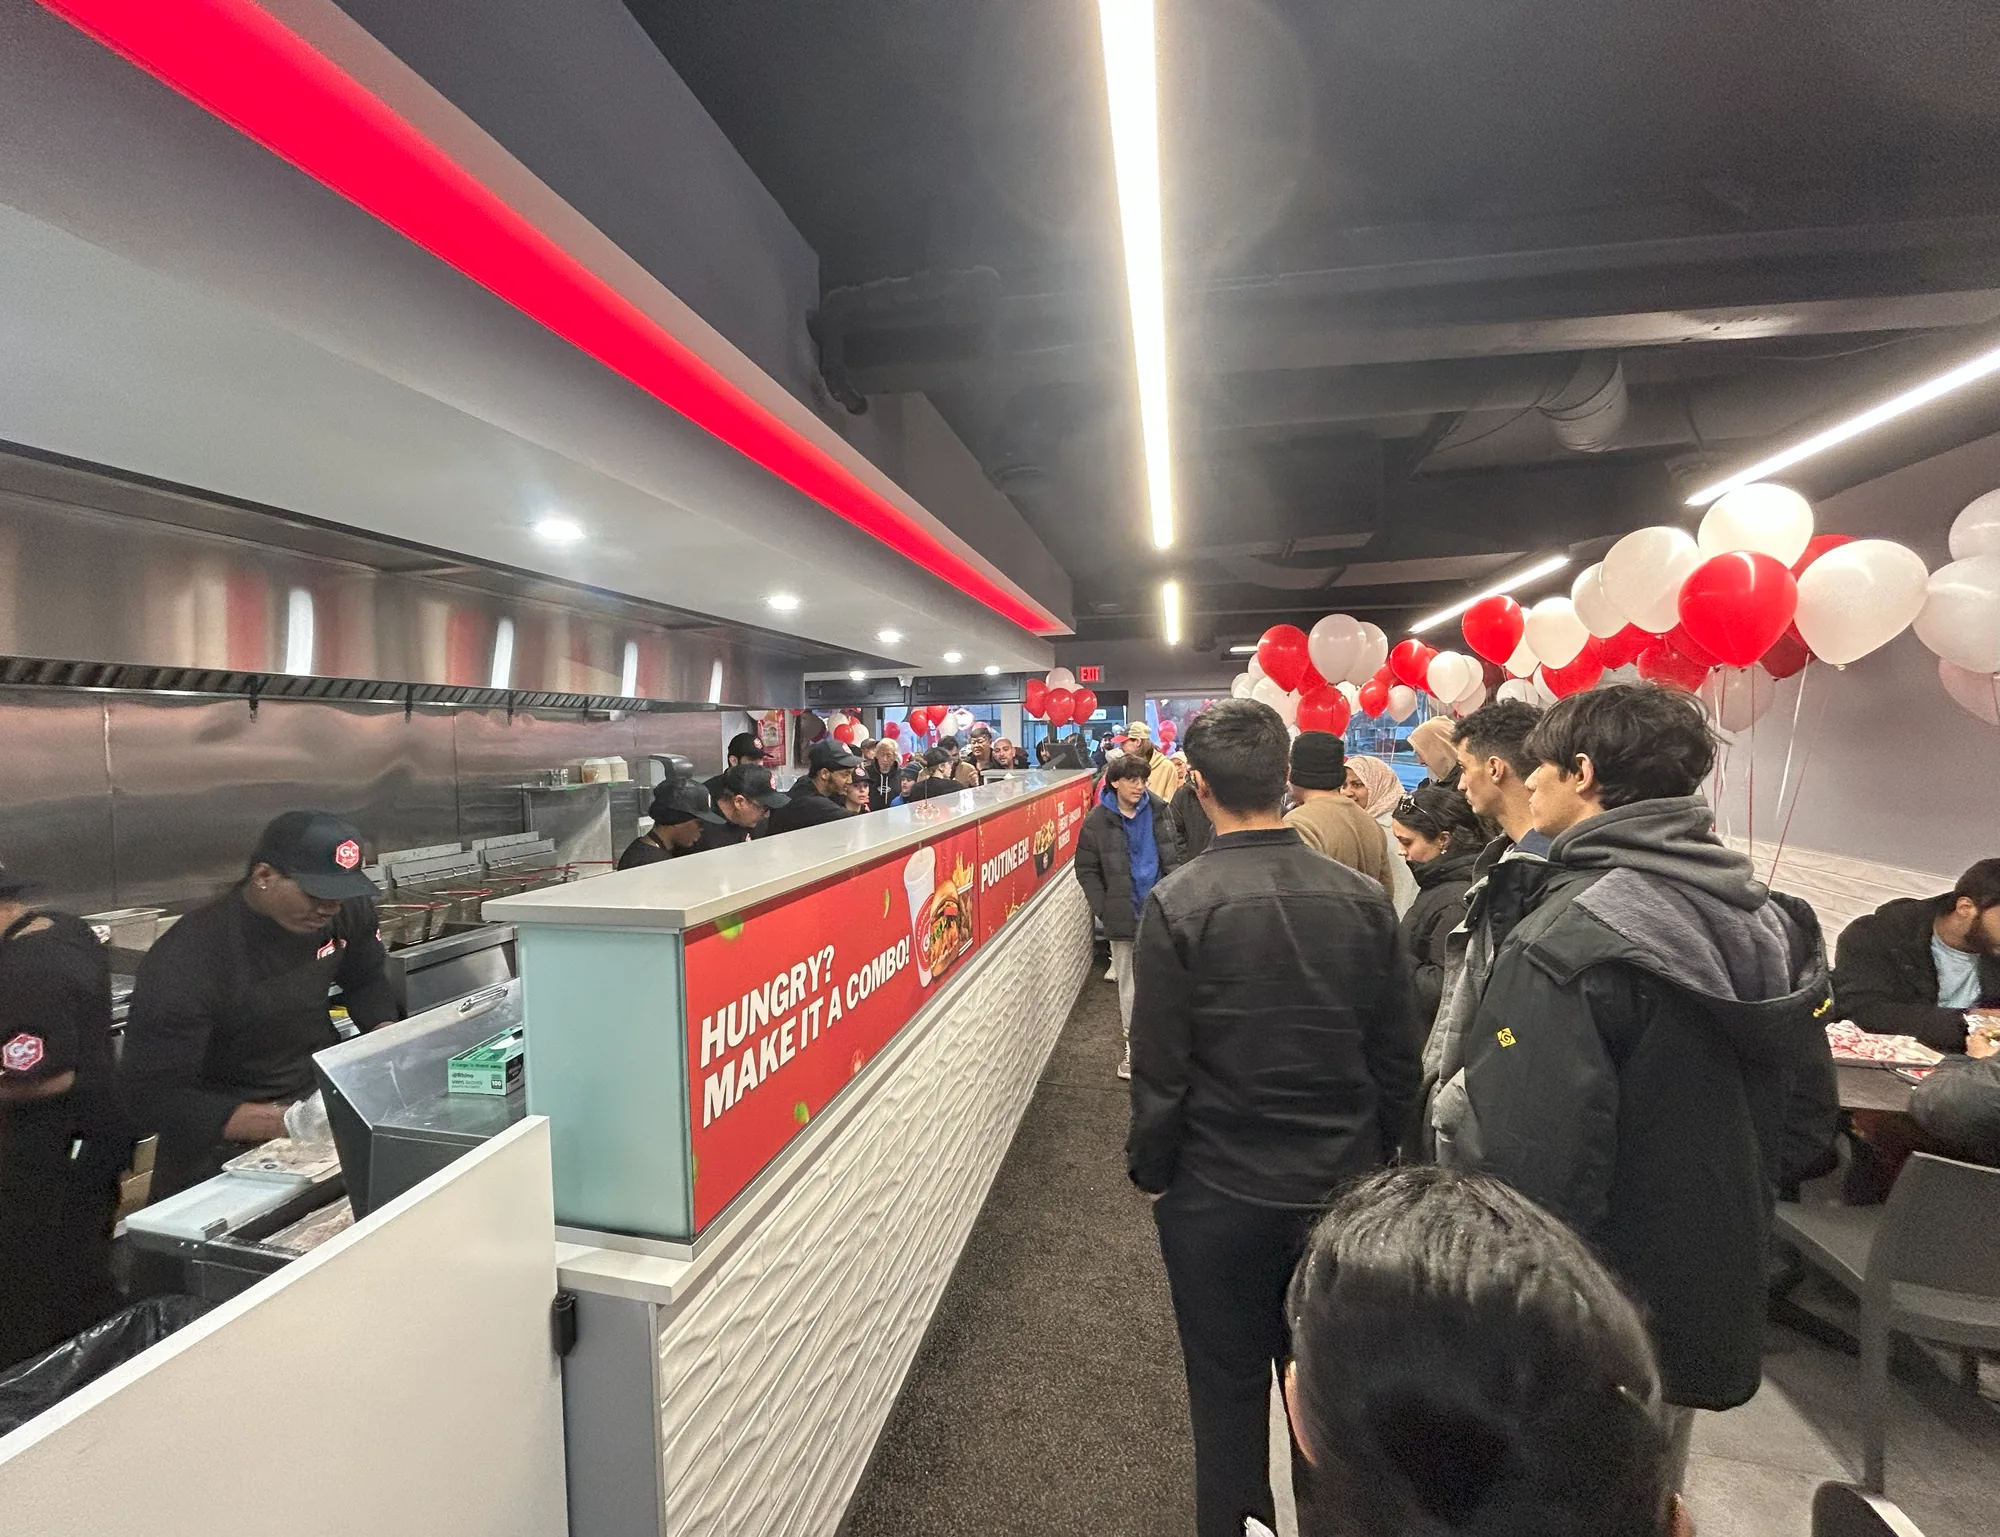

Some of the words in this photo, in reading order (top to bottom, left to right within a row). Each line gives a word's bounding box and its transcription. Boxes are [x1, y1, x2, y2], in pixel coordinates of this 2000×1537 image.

[1080, 666, 1099, 682] EXIT
[340, 845, 357, 858] GC
[981, 843, 1018, 893] POUTINE
[1018, 836, 1030, 867] EH!
[701, 945, 835, 1068] HUNGRY?
[9, 1040, 37, 1057] GC
[703, 1016, 797, 1128] MAKE
[801, 996, 824, 1050] IT
[826, 986, 842, 1028] A
[846, 935, 910, 1010] COMBO!
